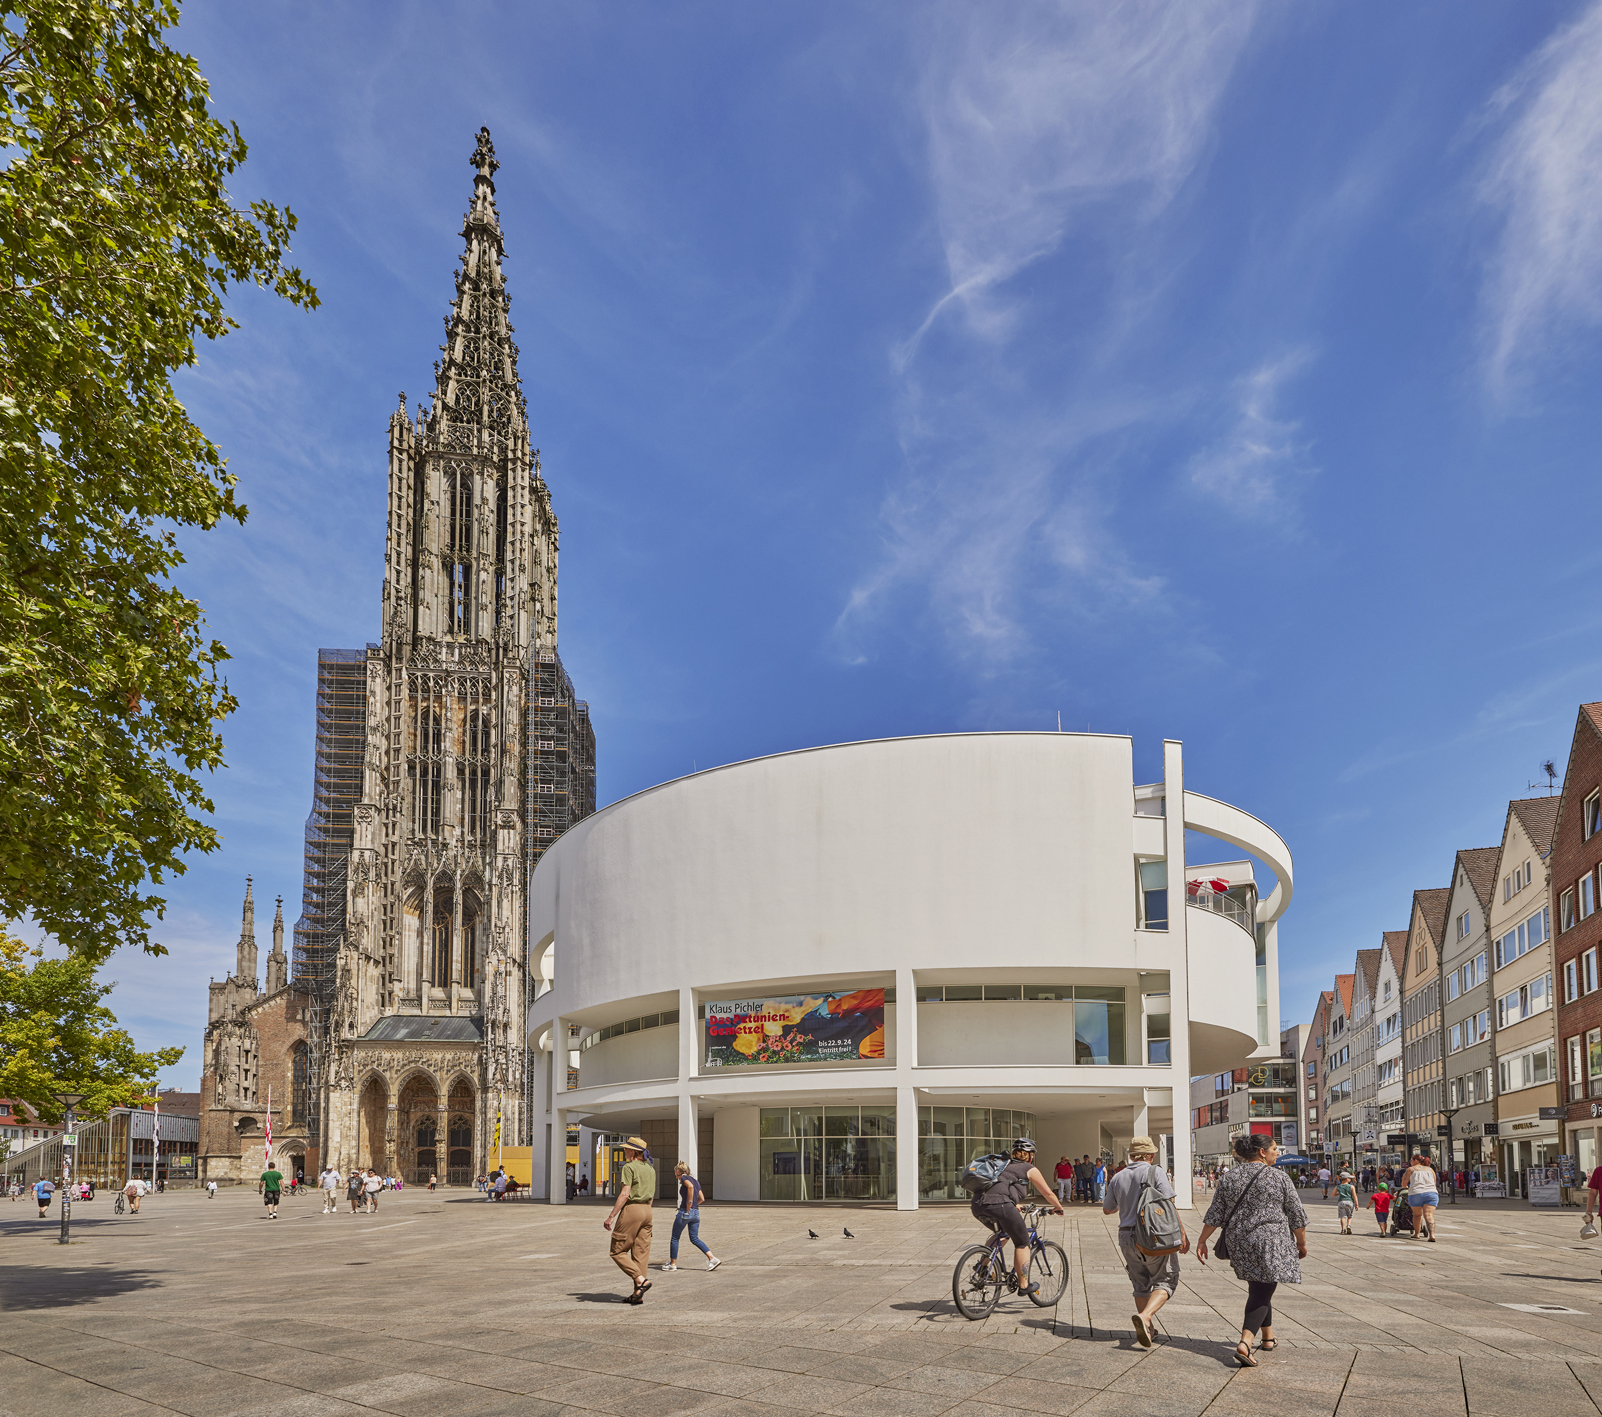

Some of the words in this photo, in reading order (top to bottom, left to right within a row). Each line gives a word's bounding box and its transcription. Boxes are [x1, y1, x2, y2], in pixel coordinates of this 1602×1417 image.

[709, 1004, 732, 1014] Klaus
[734, 1001, 764, 1013] Pichler
[709, 1015, 731, 1025] Das
[733, 1012, 790, 1025] Petunien-
[709, 1023, 764, 1037] Gemetzel
